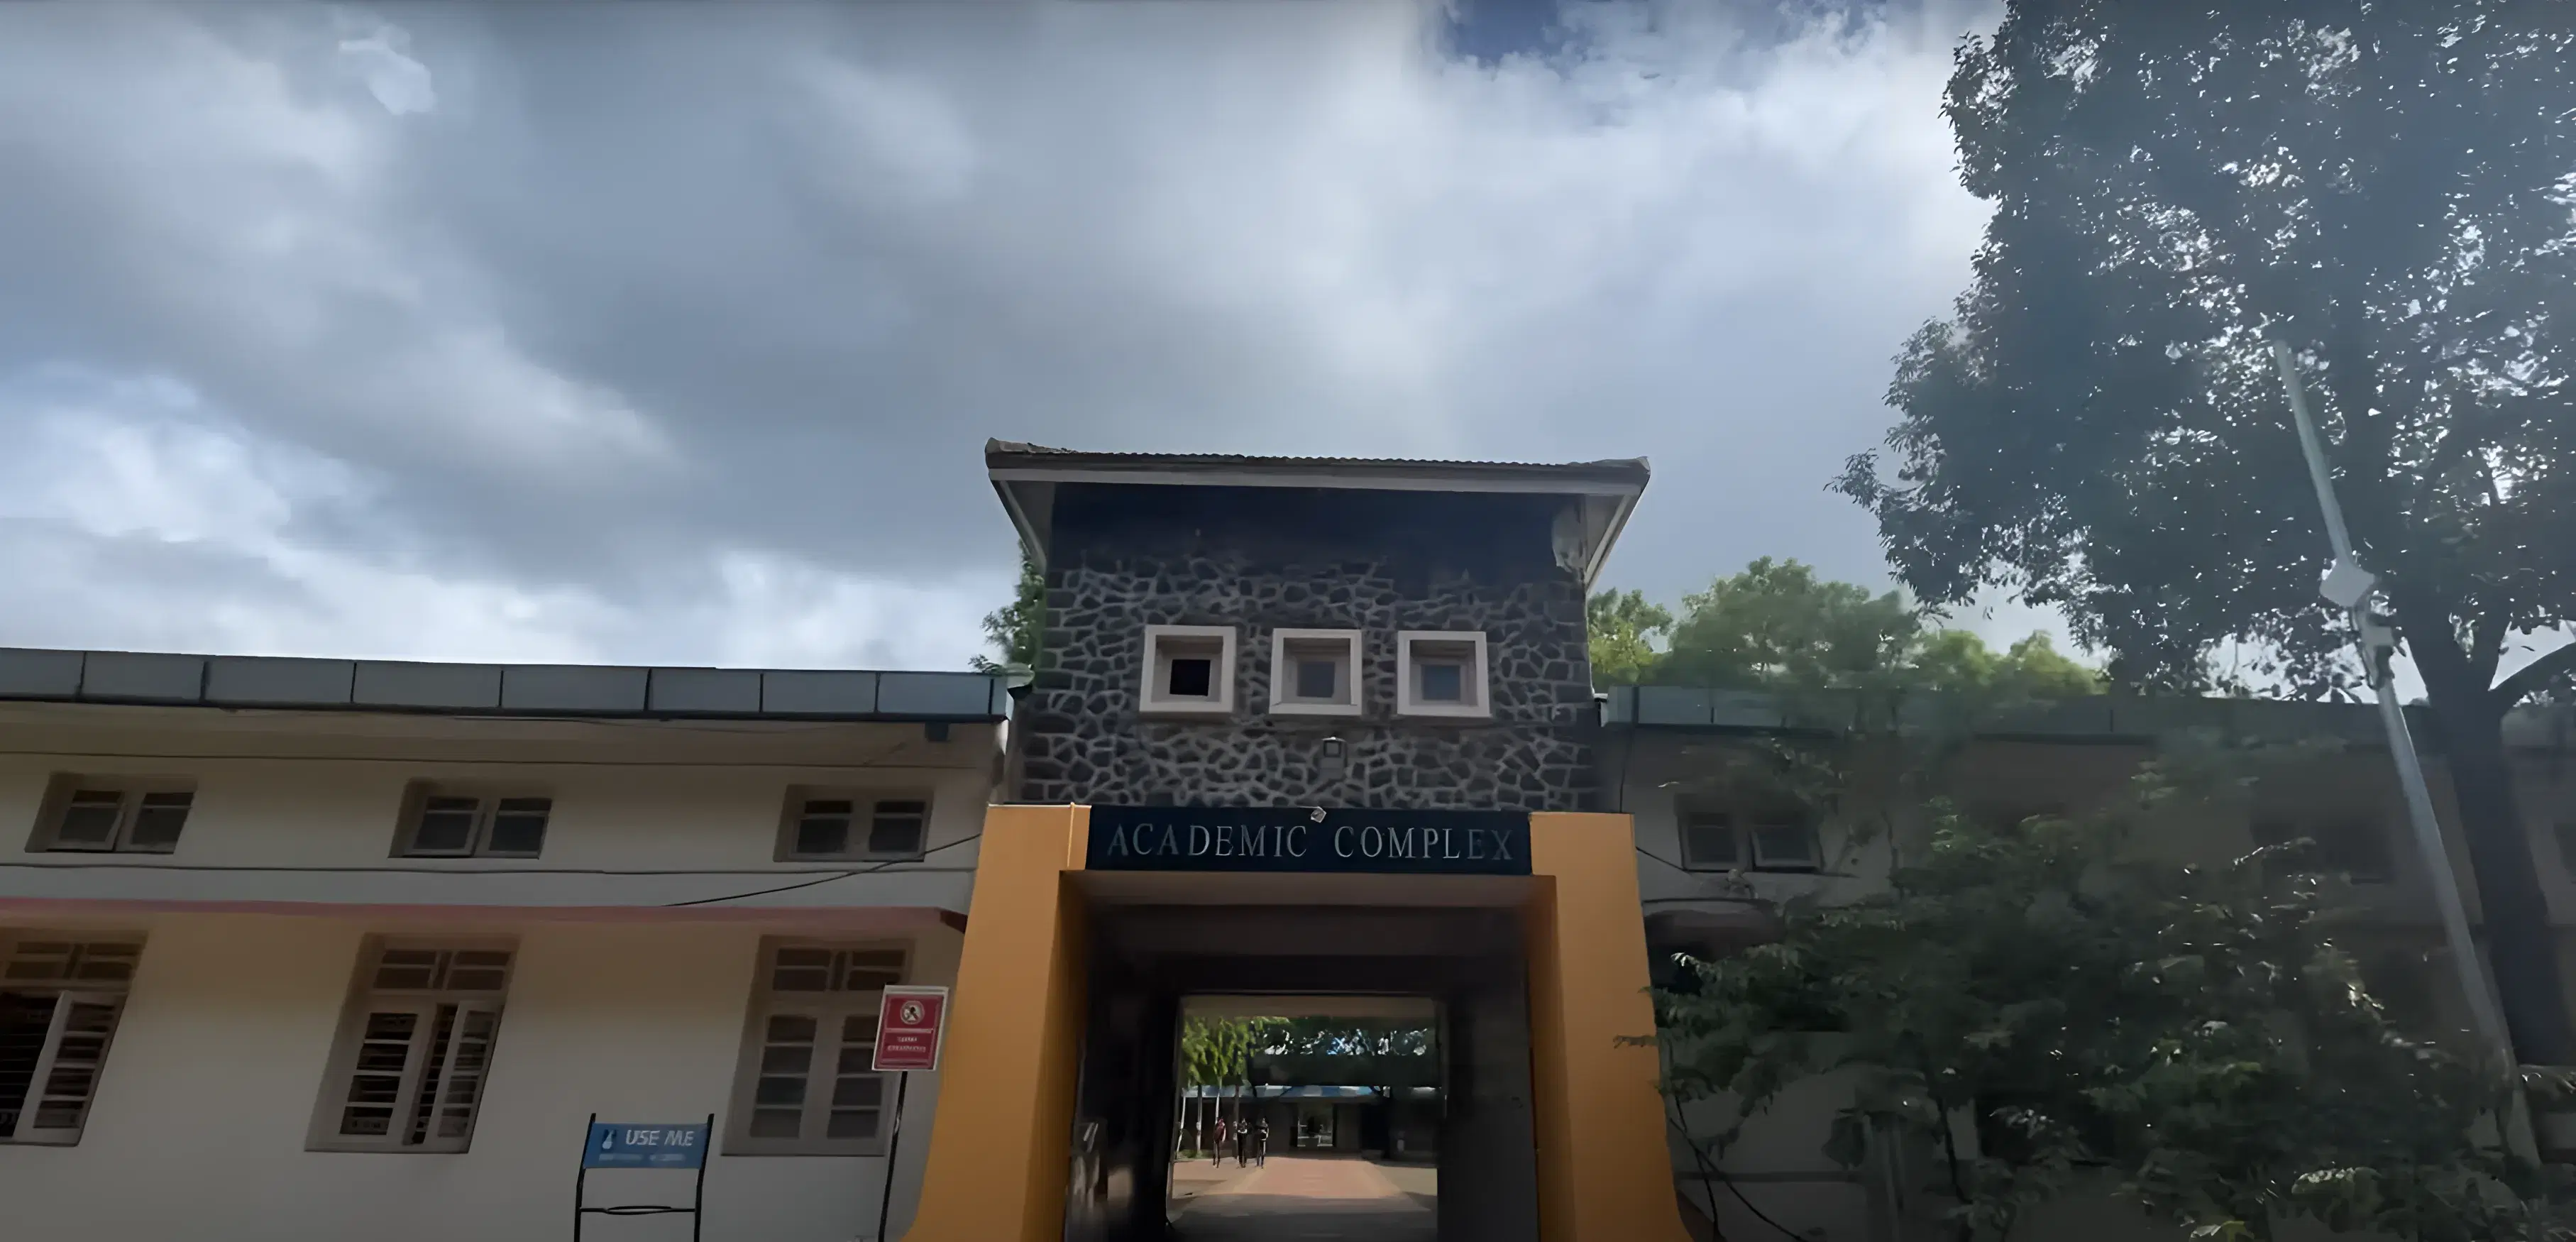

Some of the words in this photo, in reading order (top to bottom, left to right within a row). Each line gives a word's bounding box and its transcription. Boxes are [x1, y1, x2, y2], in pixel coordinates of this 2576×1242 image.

[1106, 823, 1307, 857] ACADEMIC
[1334, 825, 1514, 860] COMPLEX
[625, 1129, 660, 1145] USE
[664, 1130, 695, 1146] ME
